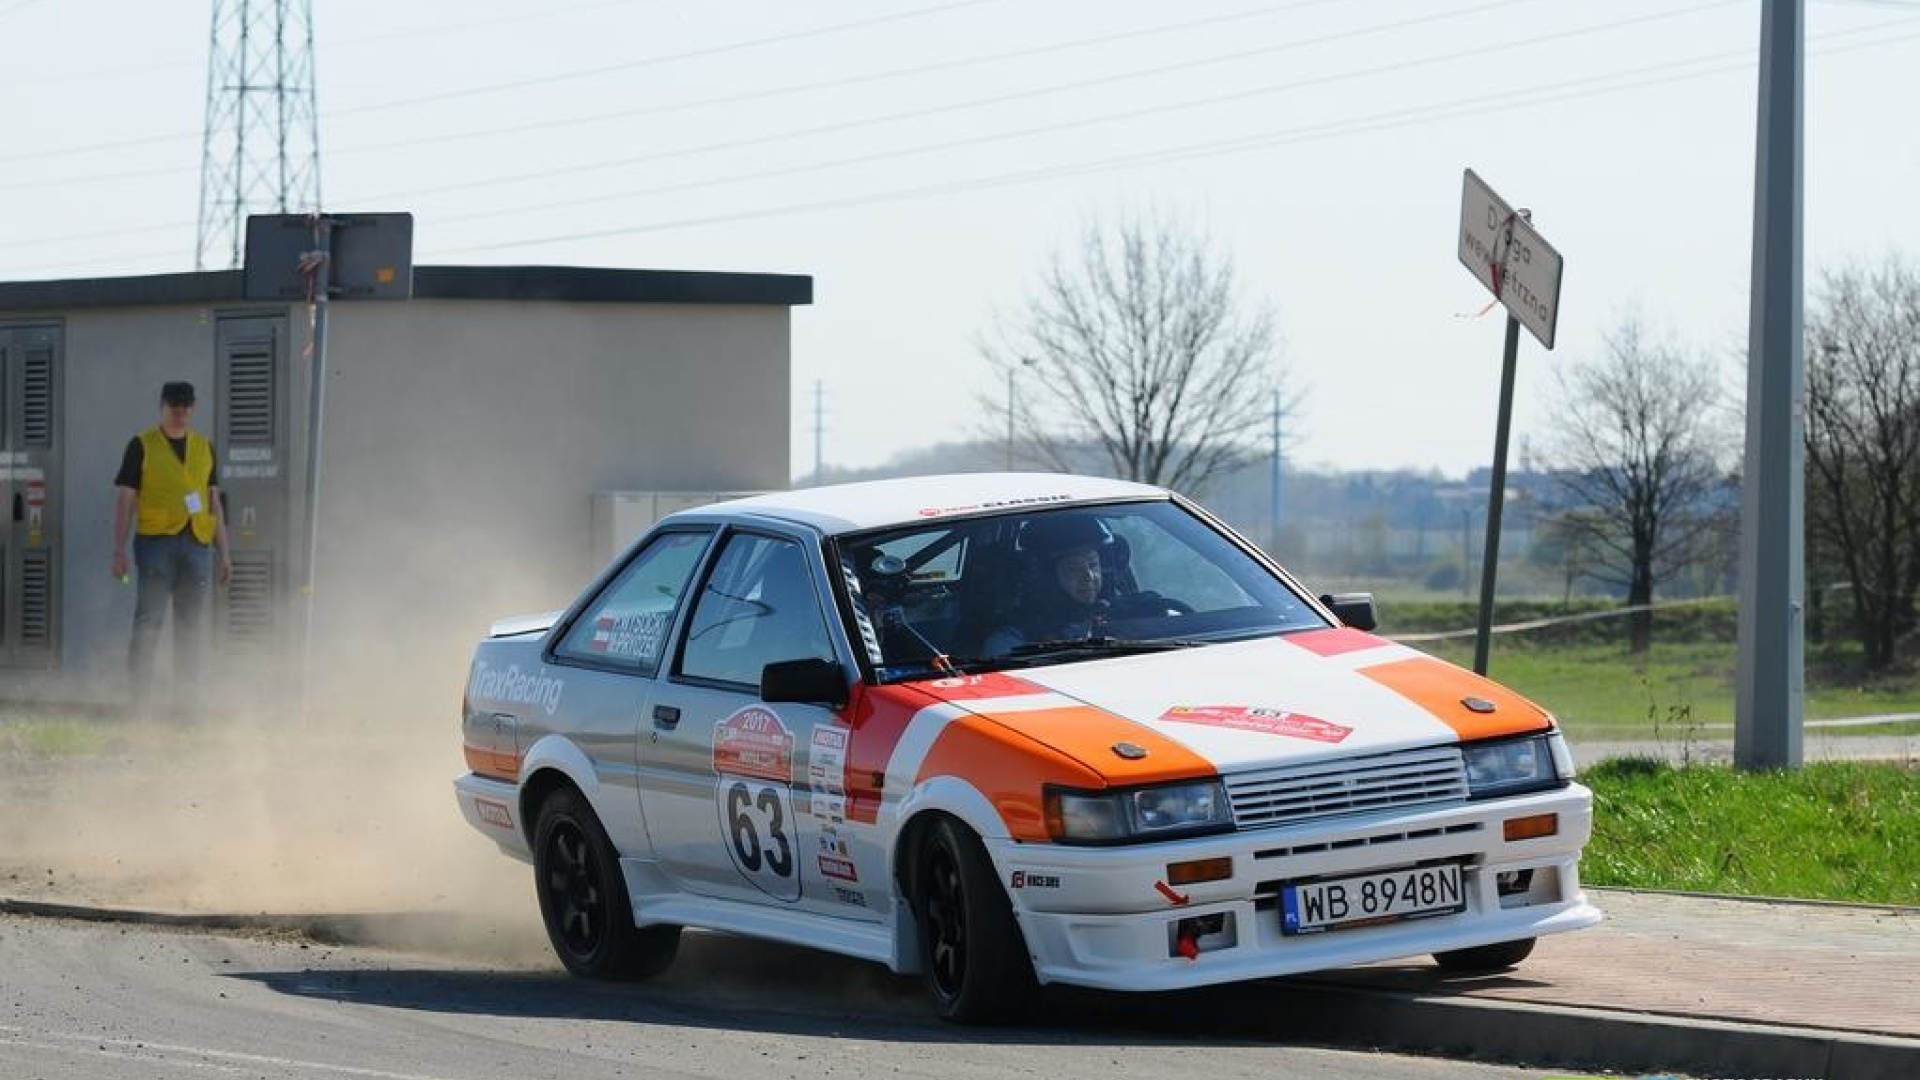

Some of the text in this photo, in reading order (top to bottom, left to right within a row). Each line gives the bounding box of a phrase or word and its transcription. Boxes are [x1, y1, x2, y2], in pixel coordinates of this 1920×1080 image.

[469, 660, 564, 715] TraxRacing
[741, 710, 771, 732] 2017
[728, 782, 792, 877] 63
[1286, 913, 1298, 923] PL
[1303, 868, 1459, 923] WB 8948N
